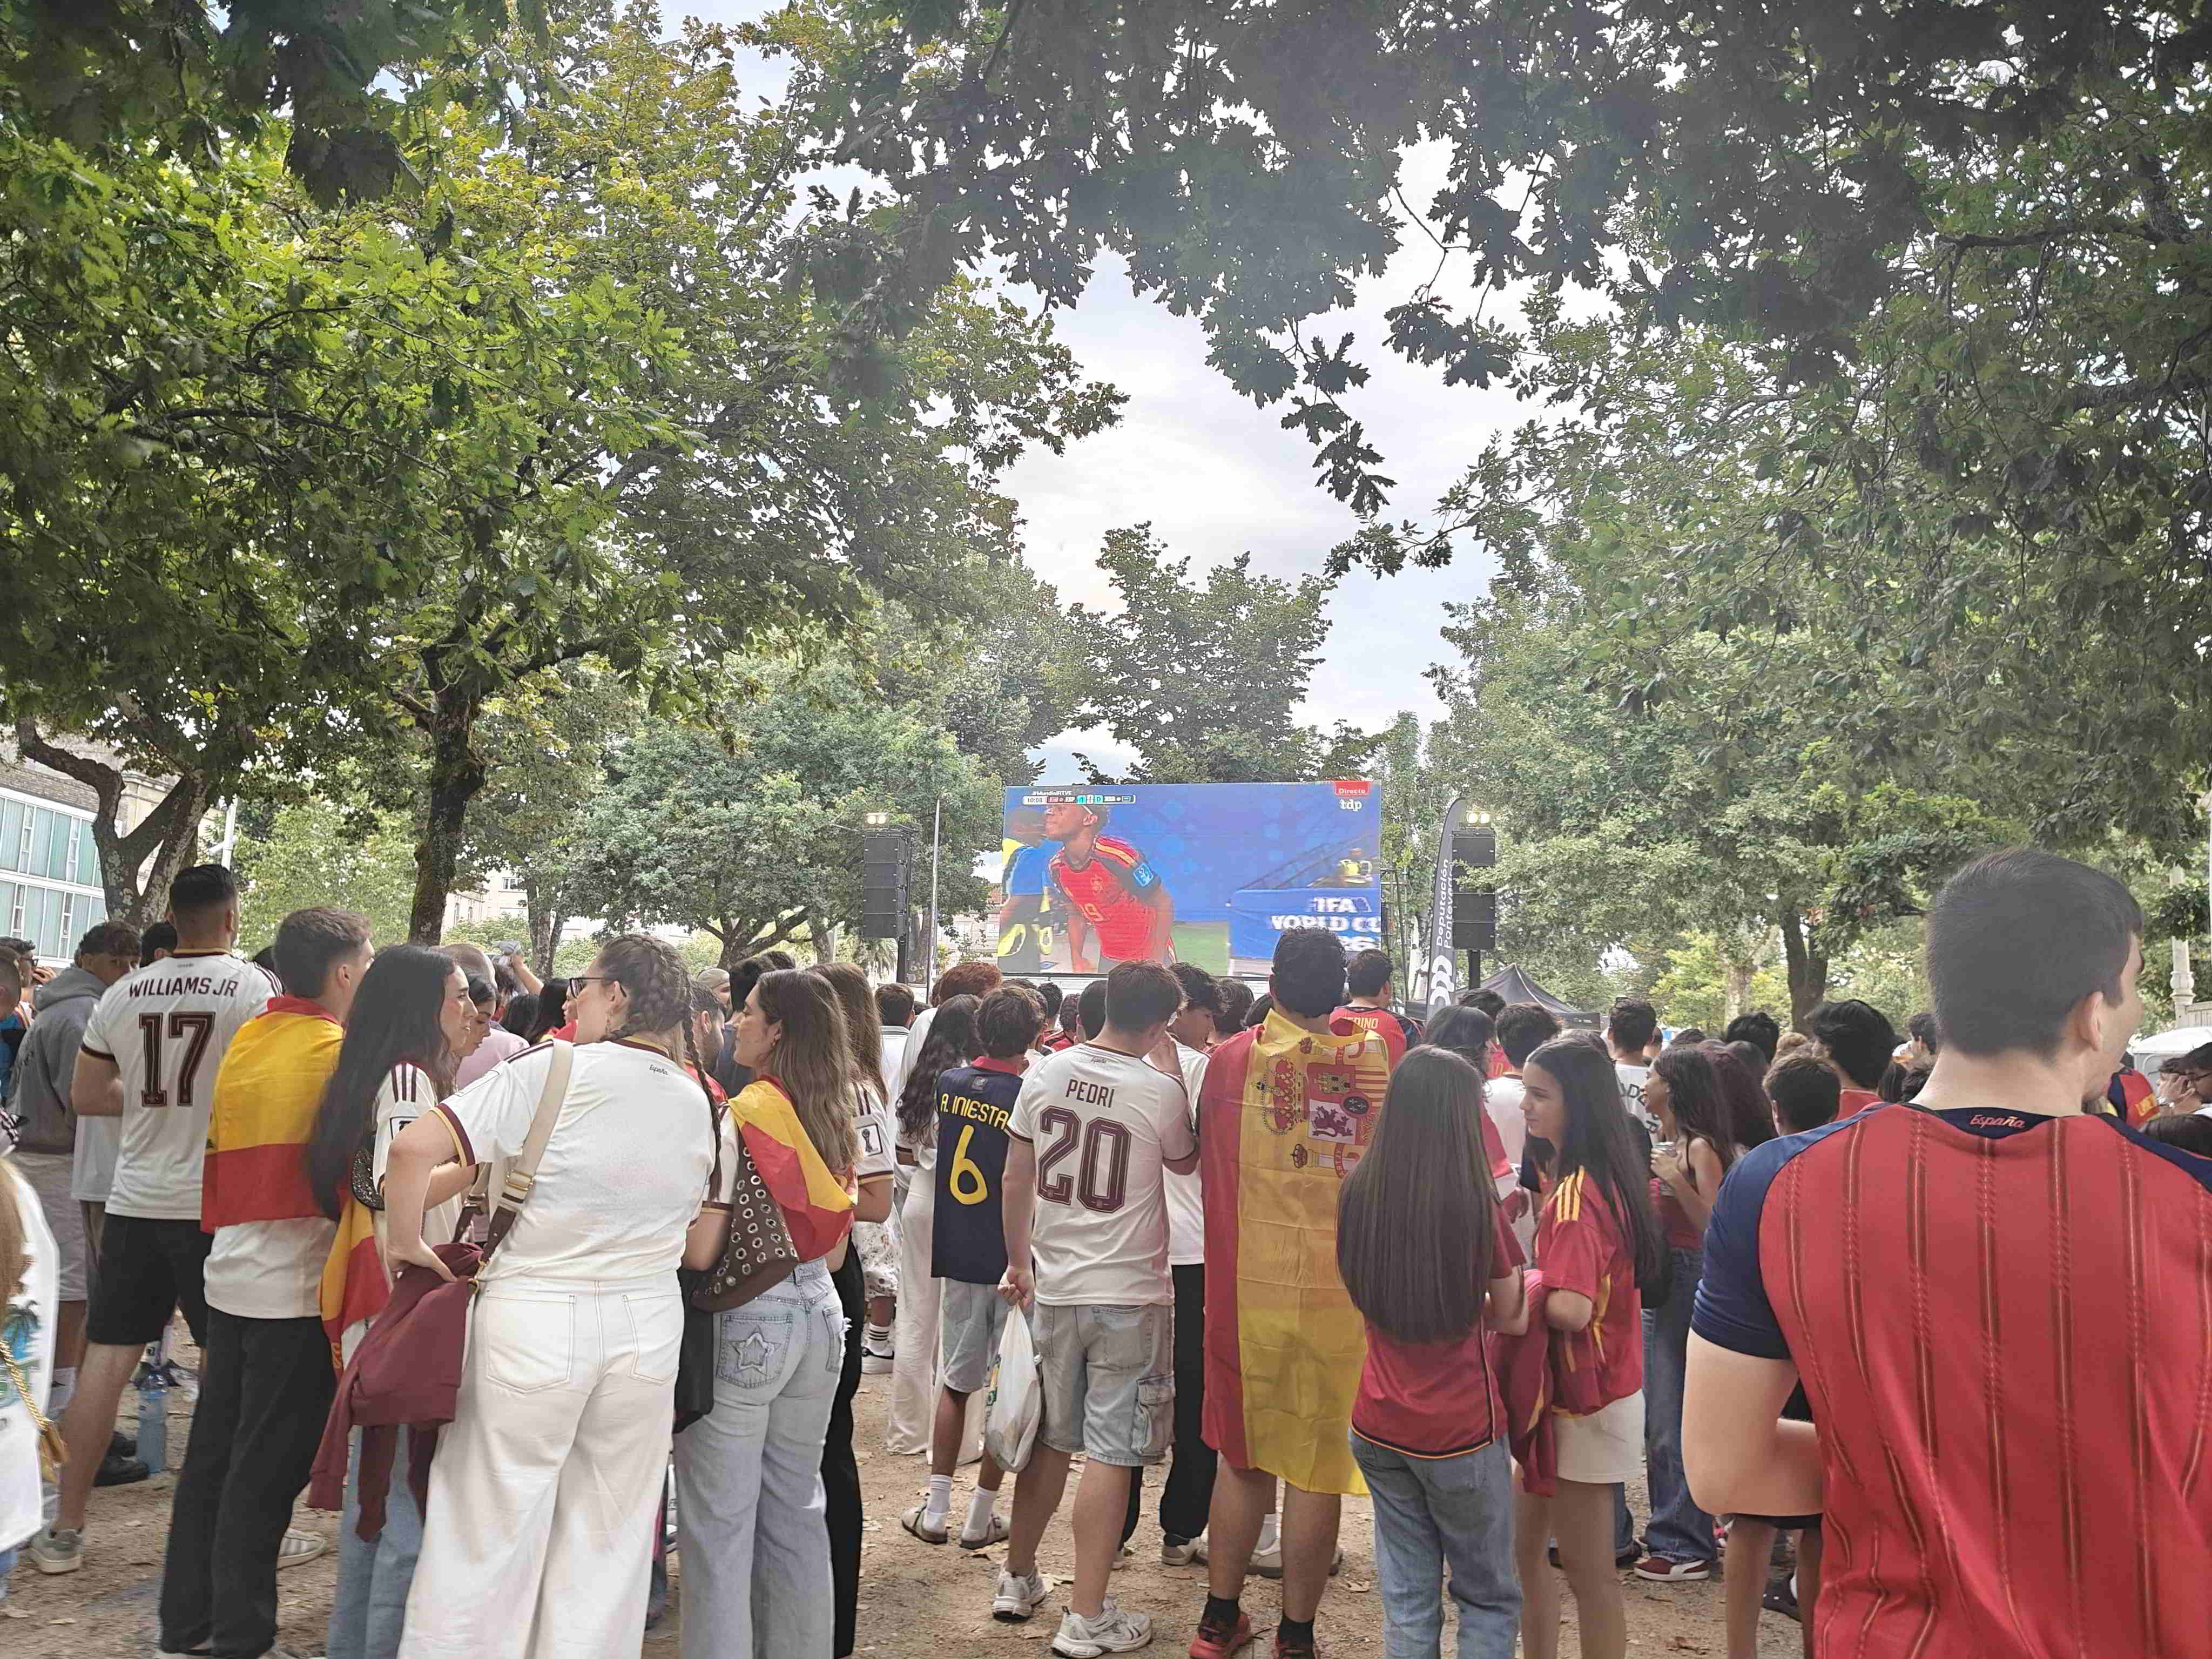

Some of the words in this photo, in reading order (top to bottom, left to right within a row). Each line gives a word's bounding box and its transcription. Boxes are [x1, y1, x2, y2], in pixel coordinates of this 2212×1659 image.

[1340, 798, 1363, 812] tdp
[1436, 859, 1449, 947] Deputación
[129, 976, 212, 997] WILLIAMS
[212, 979, 239, 997] JR
[139, 1011, 216, 1107] 17
[940, 1093, 949, 1113] A.
[952, 1095, 1009, 1130] INIESTA
[1065, 1079, 1115, 1108] PEDRI
[1970, 1114, 2025, 1129] España
[950, 1124, 988, 1205] 6
[1037, 1105, 1132, 1213] 20
